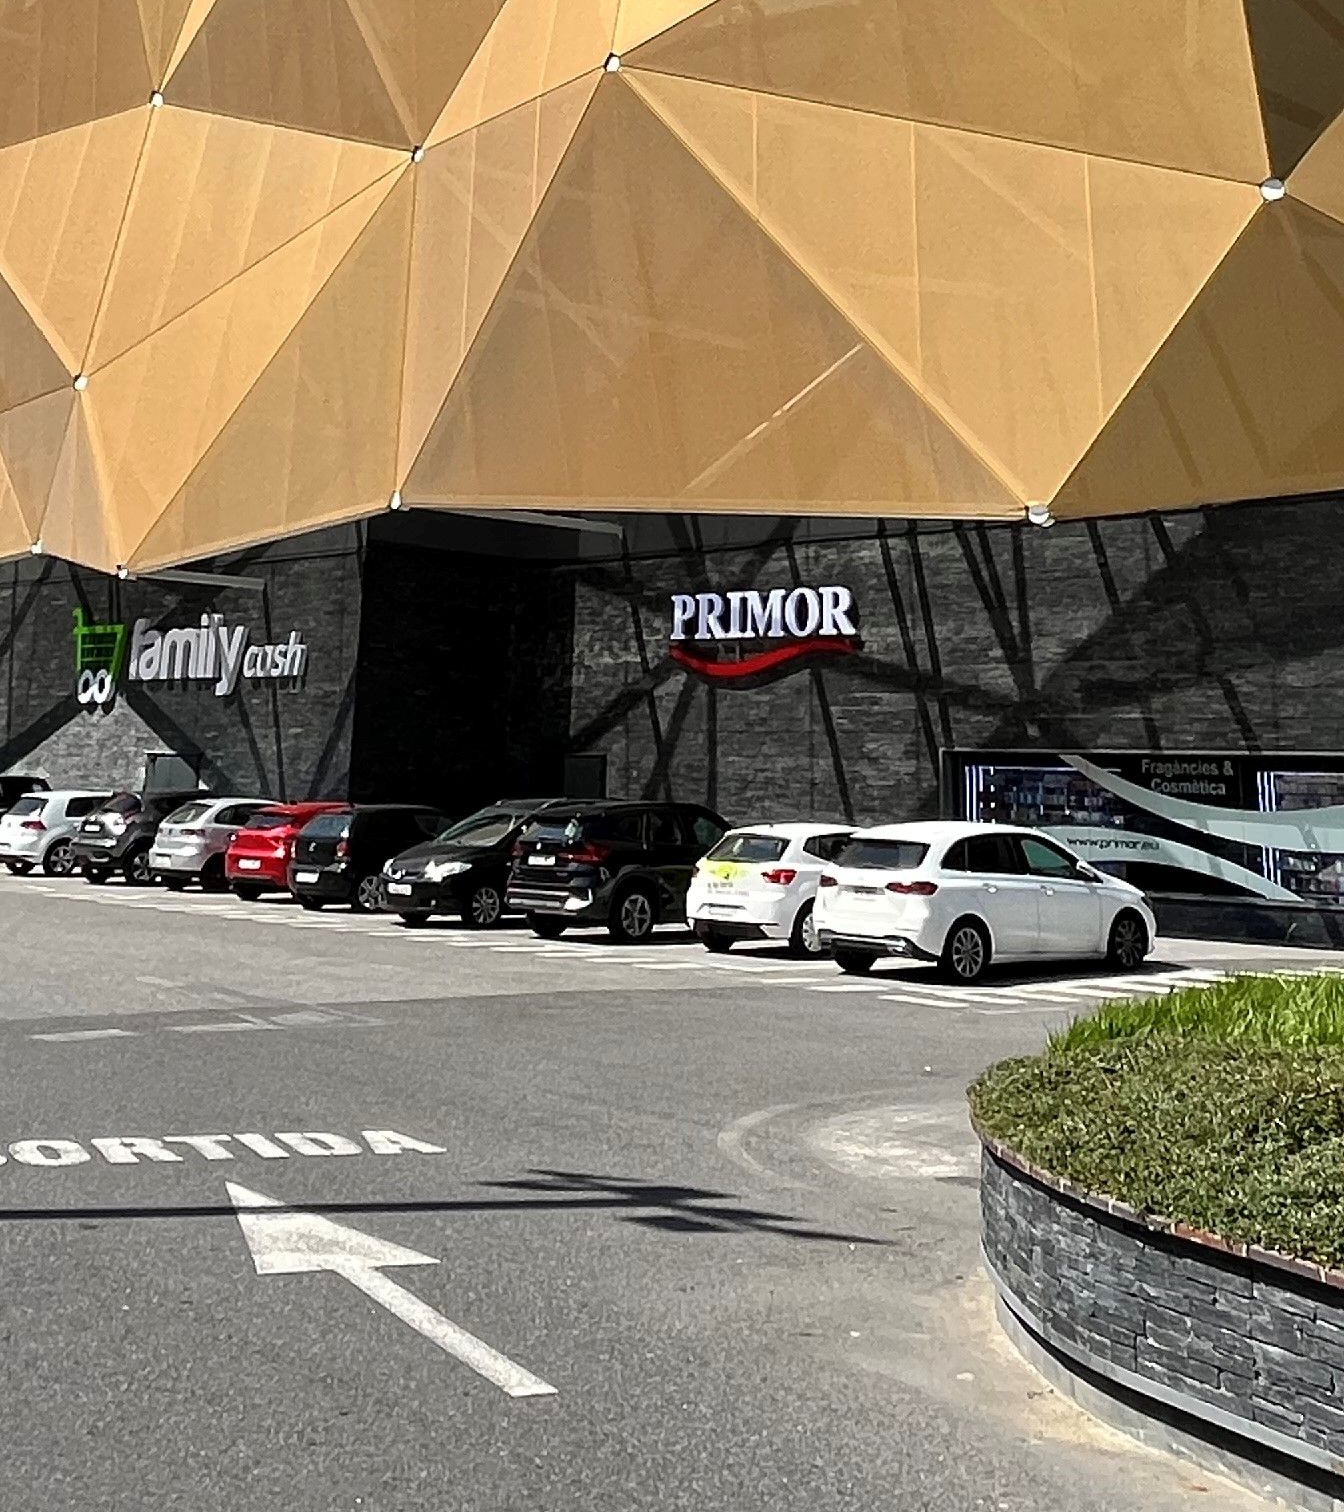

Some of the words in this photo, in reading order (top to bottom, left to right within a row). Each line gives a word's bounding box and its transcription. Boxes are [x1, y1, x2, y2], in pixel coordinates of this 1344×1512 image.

[670, 586, 857, 640] PRIMOR
[128, 613, 250, 696] family
[243, 631, 308, 678] cash
[1141, 758, 1219, 777] Fragàncies
[1223, 760, 1234, 776] &
[1151, 778, 1226, 795] Cosmètica
